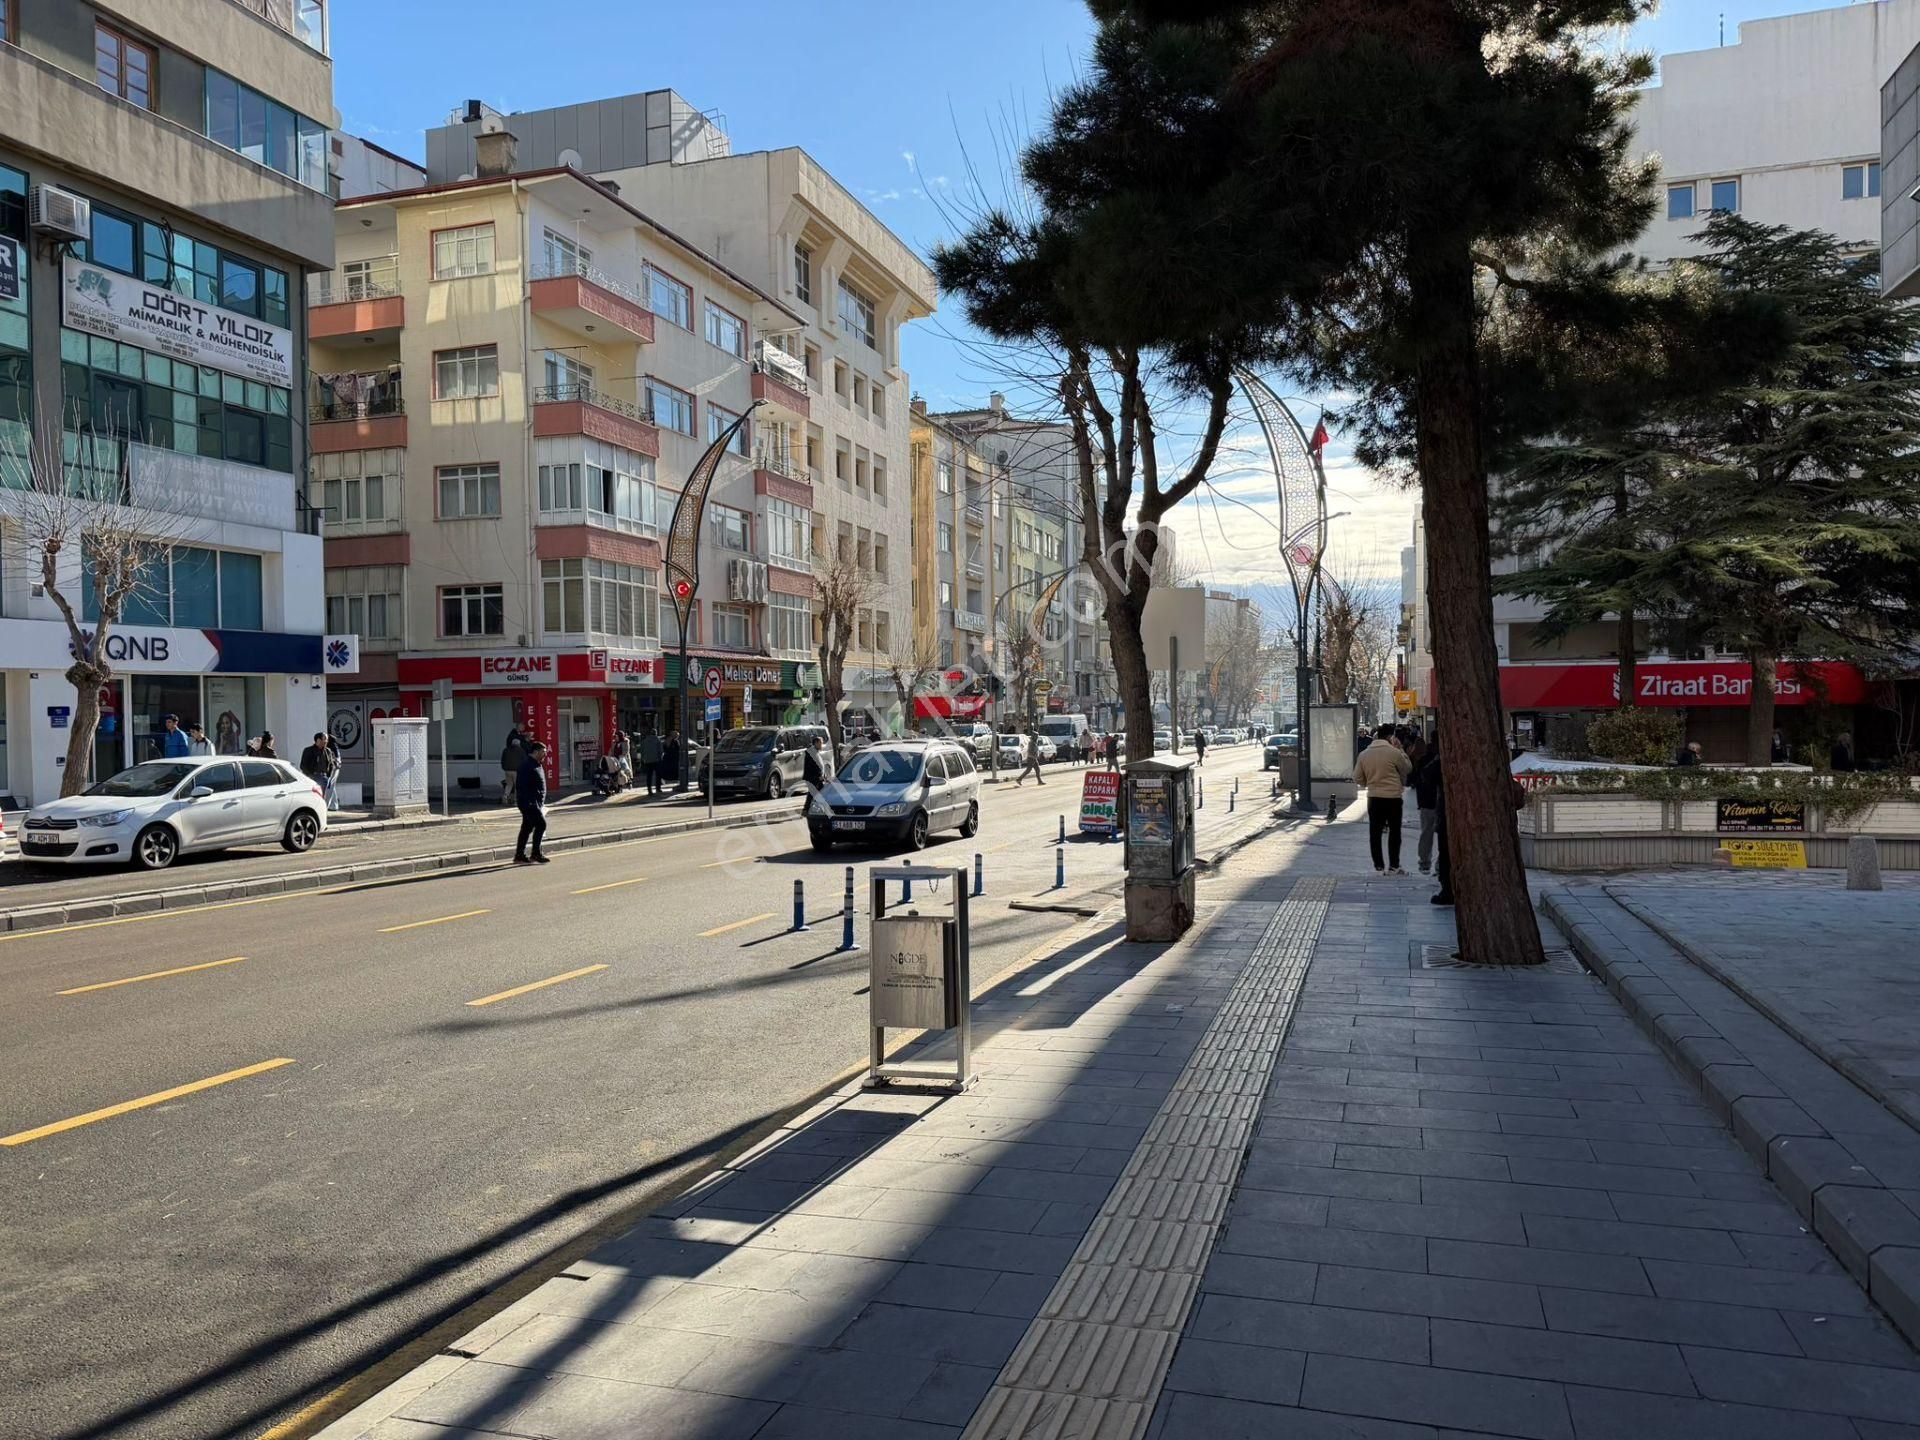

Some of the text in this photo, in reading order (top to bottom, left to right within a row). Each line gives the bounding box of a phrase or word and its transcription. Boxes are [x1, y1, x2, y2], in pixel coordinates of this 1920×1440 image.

[143, 291, 273, 347] DÖRT YILDIZ
[129, 307, 285, 363] MİMARLIK & MÜHENDİSLİK
[105, 635, 169, 661] QNB
[484, 656, 552, 673] ECZANE
[594, 653, 604, 666] E
[610, 658, 653, 674] ECZANE
[507, 674, 529, 682] GÜNEŞ
[724, 664, 781, 684] Melisa Döner
[1641, 675, 1708, 696] Ziraat
[1088, 775, 1114, 785] KAPALI
[1084, 785, 1117, 795] OTOPARK
[1722, 803, 1767, 816] Vitamin
